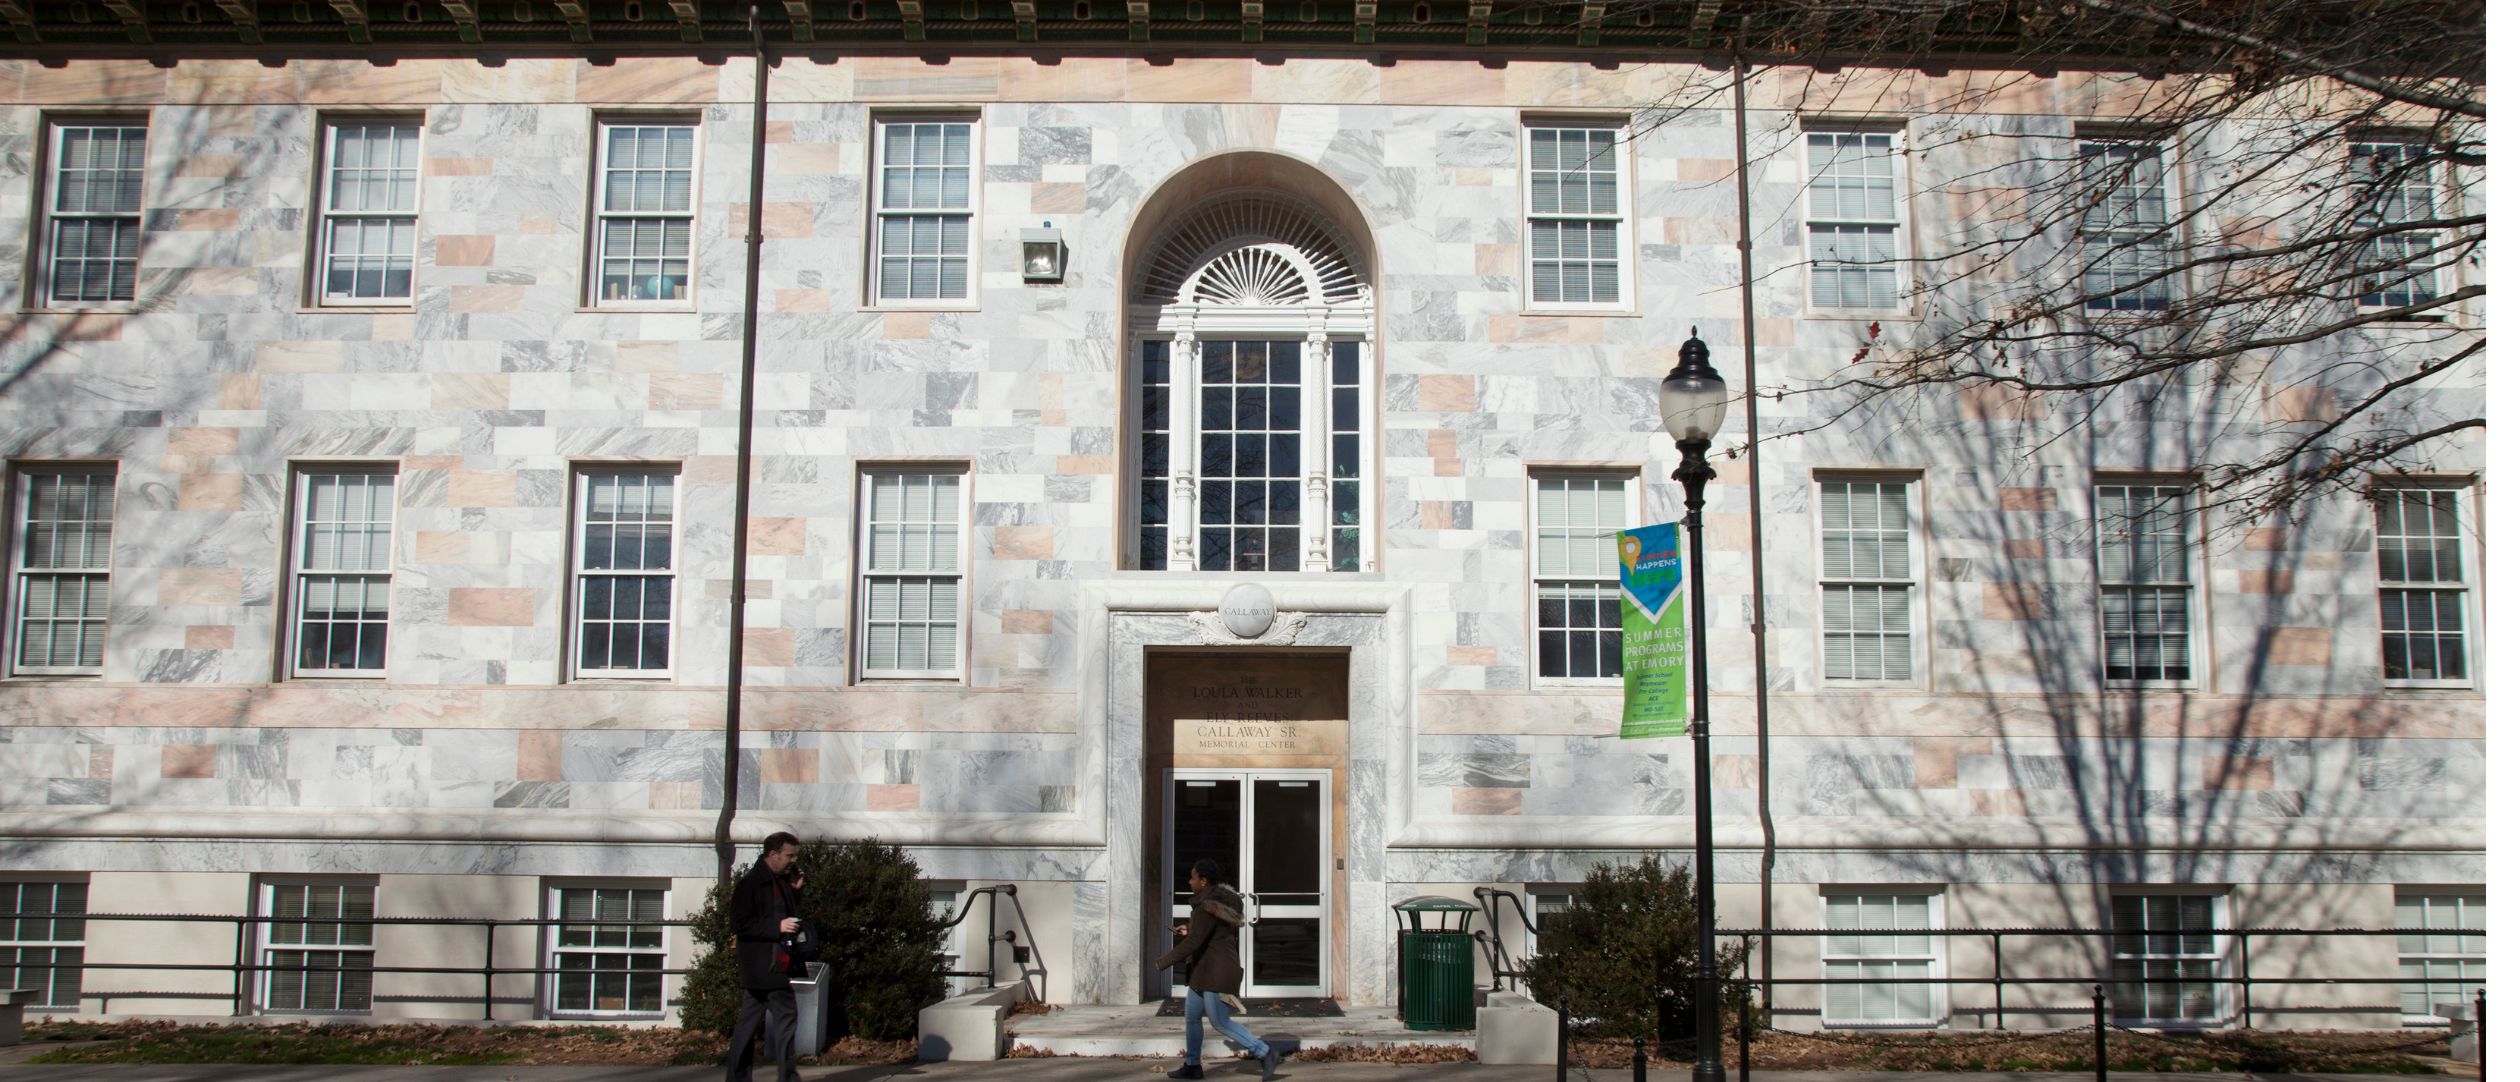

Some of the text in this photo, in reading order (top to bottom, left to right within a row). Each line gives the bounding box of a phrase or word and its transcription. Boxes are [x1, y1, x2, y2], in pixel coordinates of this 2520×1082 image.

[1636, 558, 1677, 571] HAPPENS
[1224, 607, 1273, 616] CALLAWAY
[1625, 627, 1682, 644] SUMMER
[1625, 641, 1684, 657] PROGRAMS
[1625, 655, 1684, 672] AT EMORY
[1193, 687, 1303, 699] LOULA WALKER
[1237, 712, 1290, 723] REEVES
[1197, 726, 1273, 738] CALLAWAY
[1199, 740, 1296, 749] MEMORIAL CENTER
